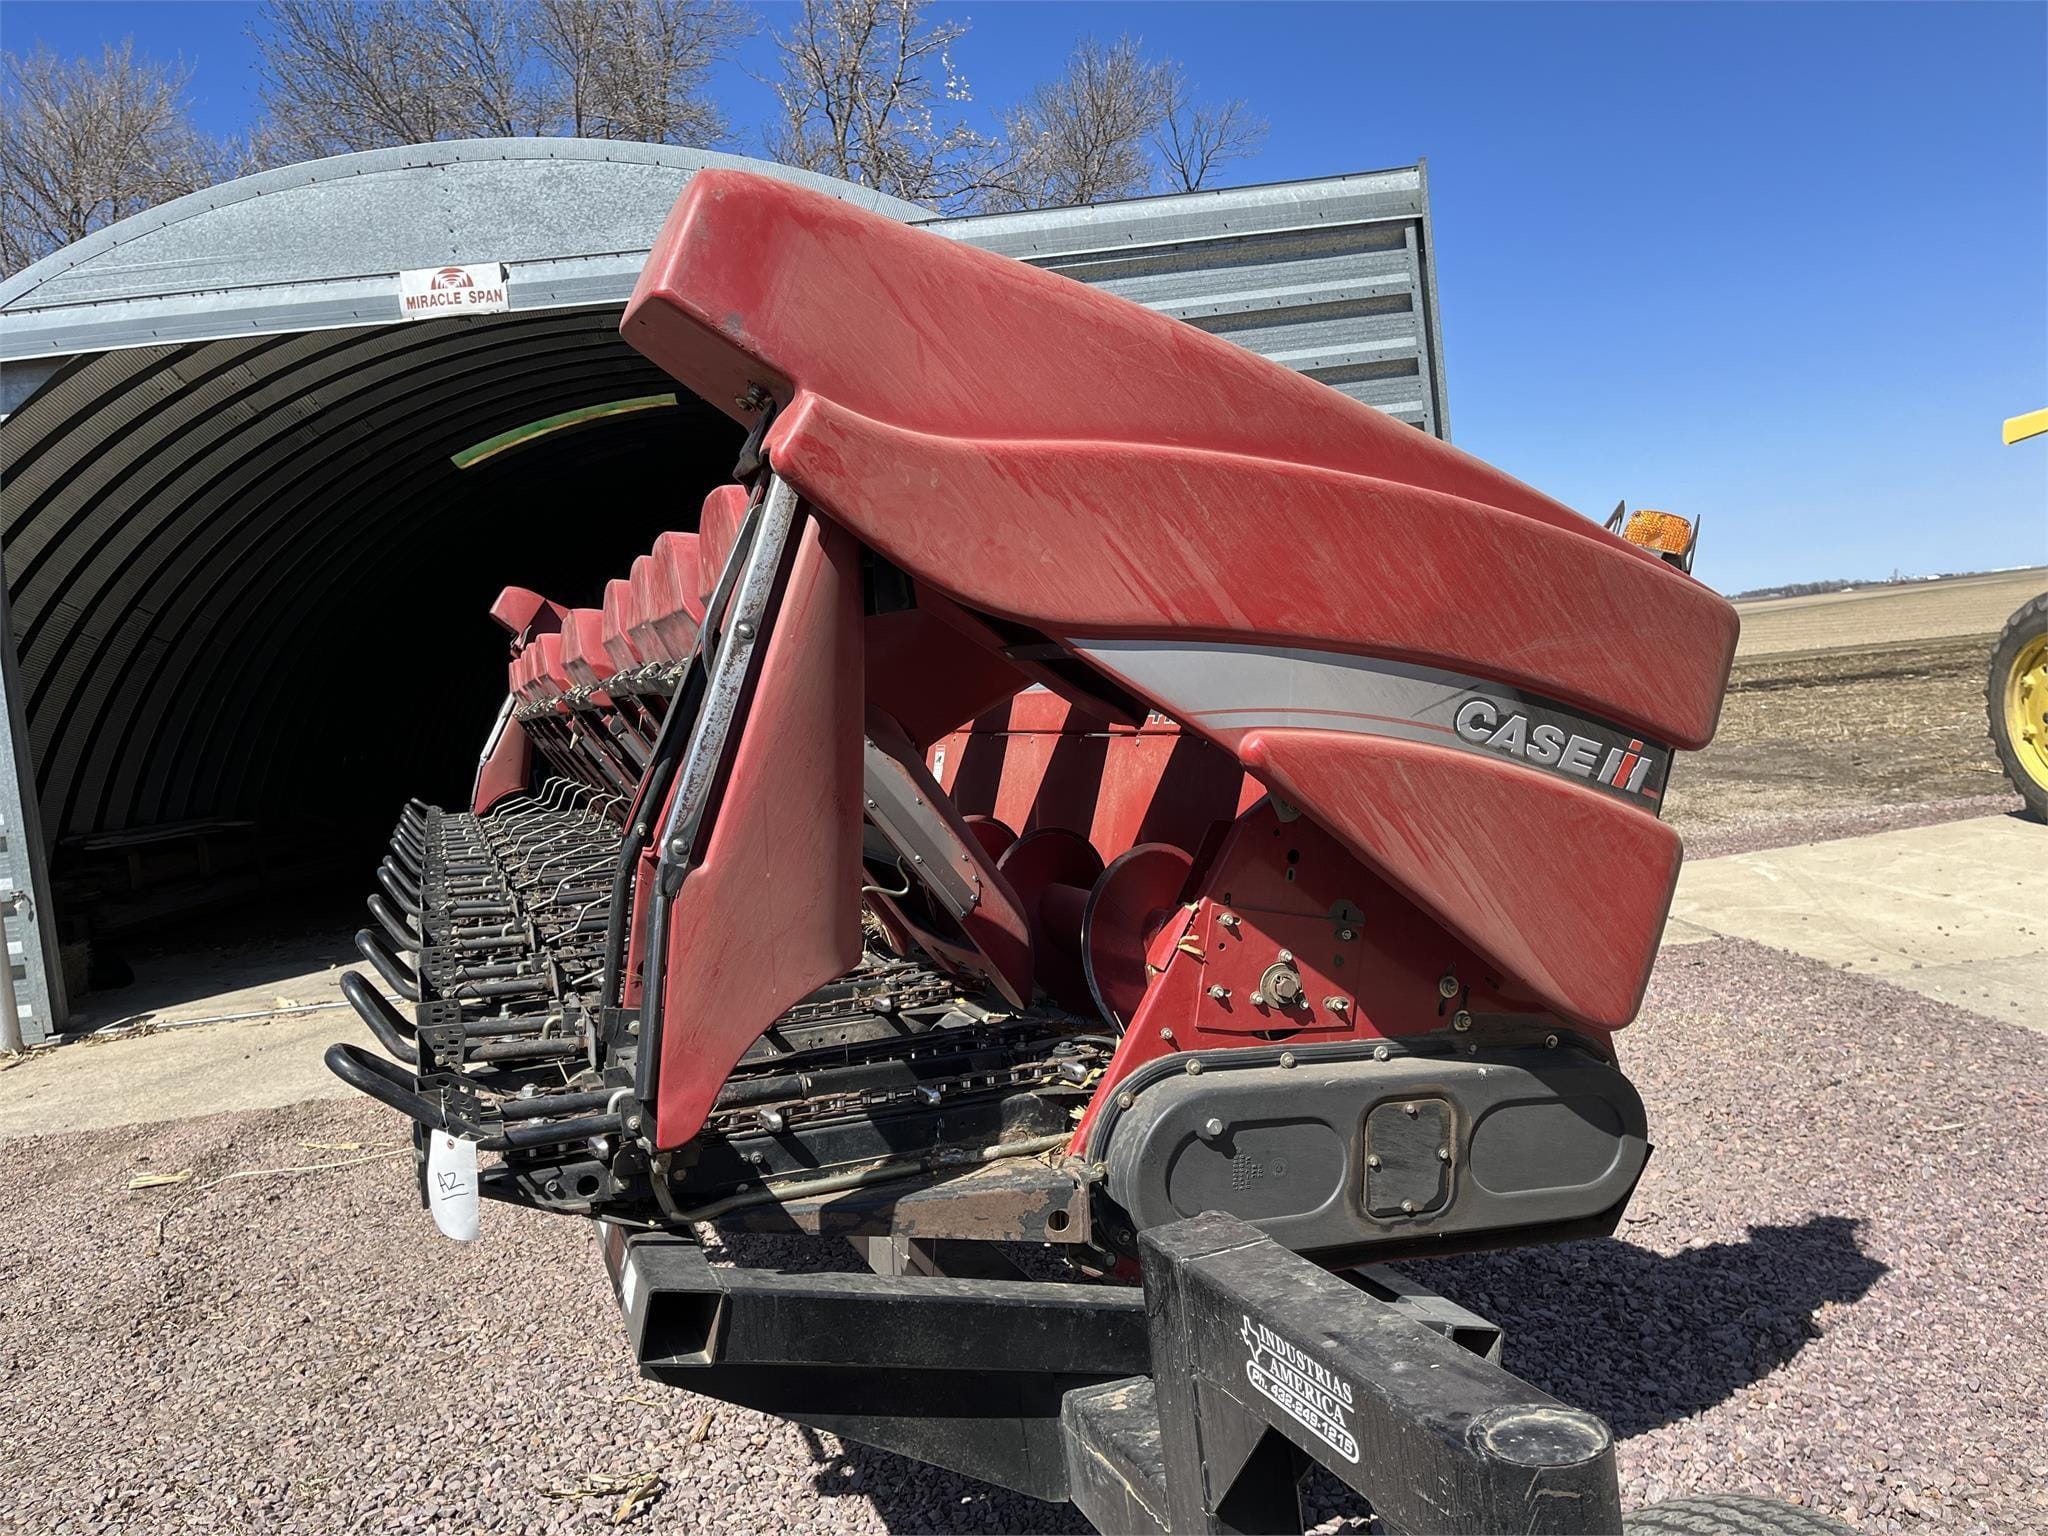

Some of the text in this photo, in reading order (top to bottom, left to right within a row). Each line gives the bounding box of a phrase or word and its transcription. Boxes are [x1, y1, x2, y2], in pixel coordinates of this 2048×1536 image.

[406, 289, 503, 310] MIRACLE SPAN
[1455, 700, 1603, 777] CASE
[1252, 1368, 1268, 1390] Ph.
[1258, 1323, 1353, 1404] INDUSTRIAS
[1269, 1358, 1347, 1428] AMERICA
